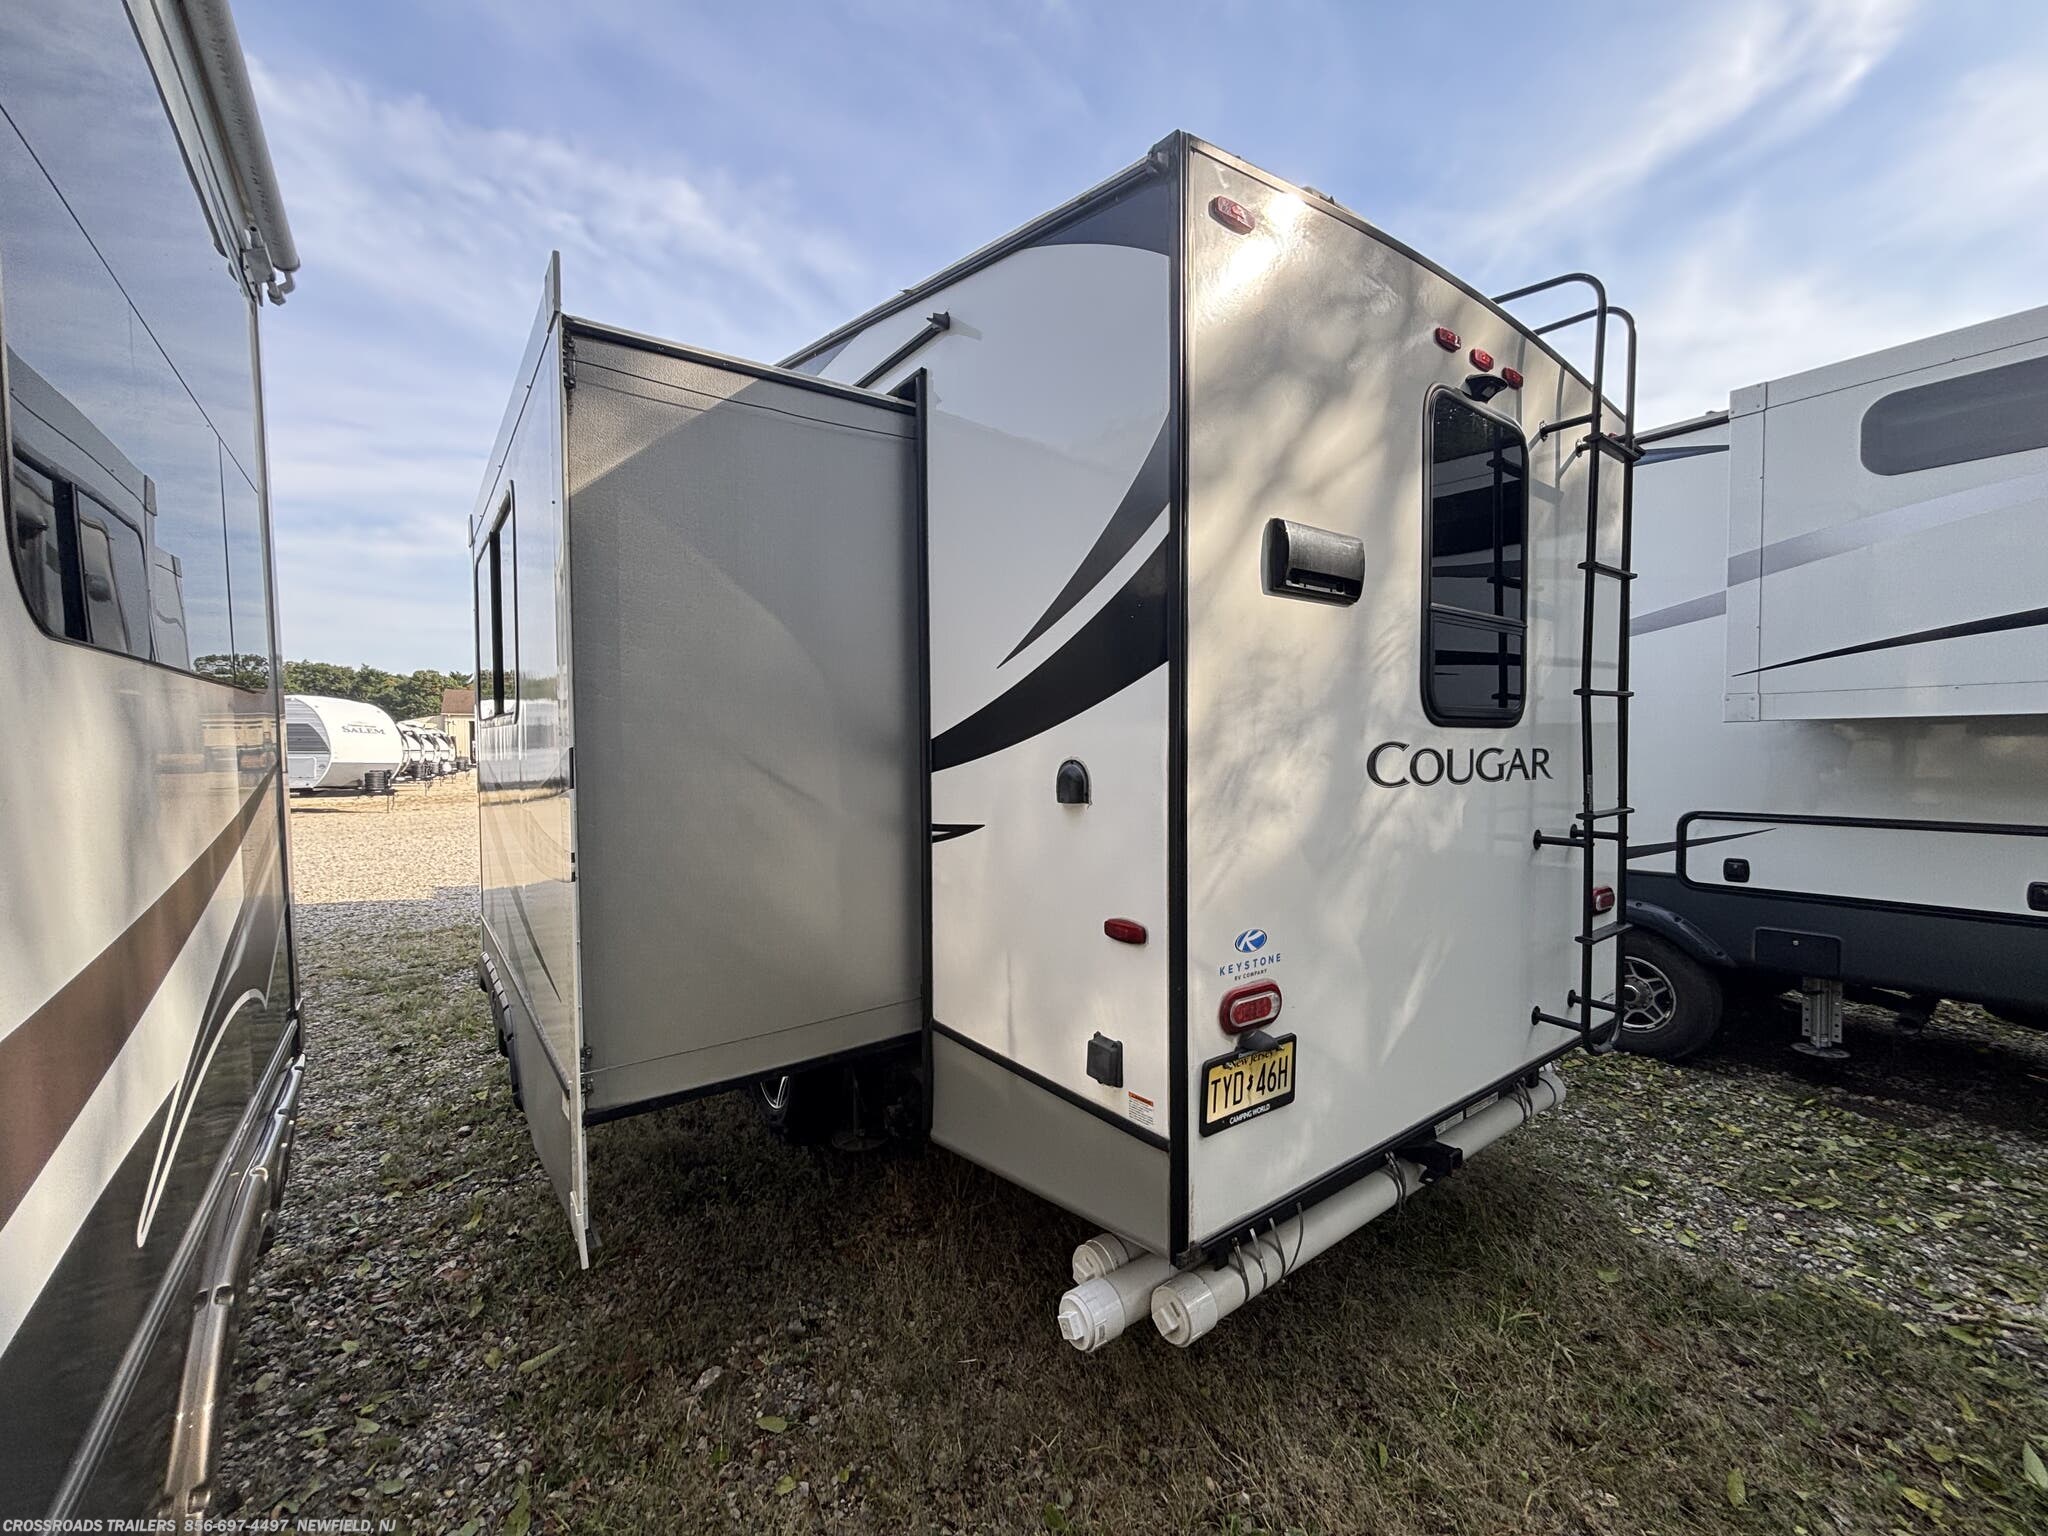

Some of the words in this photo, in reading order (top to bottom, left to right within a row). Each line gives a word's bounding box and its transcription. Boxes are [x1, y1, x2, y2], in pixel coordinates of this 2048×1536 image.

[341, 725, 387, 735] SALEM
[1366, 741, 1554, 788] COUGAR
[1218, 953, 1282, 977] KEYSTONE
[1242, 968, 1268, 979] COMPANY
[1210, 1070, 1245, 1114] TYD
[1255, 1055, 1289, 1096] 46H
[1229, 1110, 1253, 1125] CAMPING
[1252, 1103, 1271, 1116] WORLD
